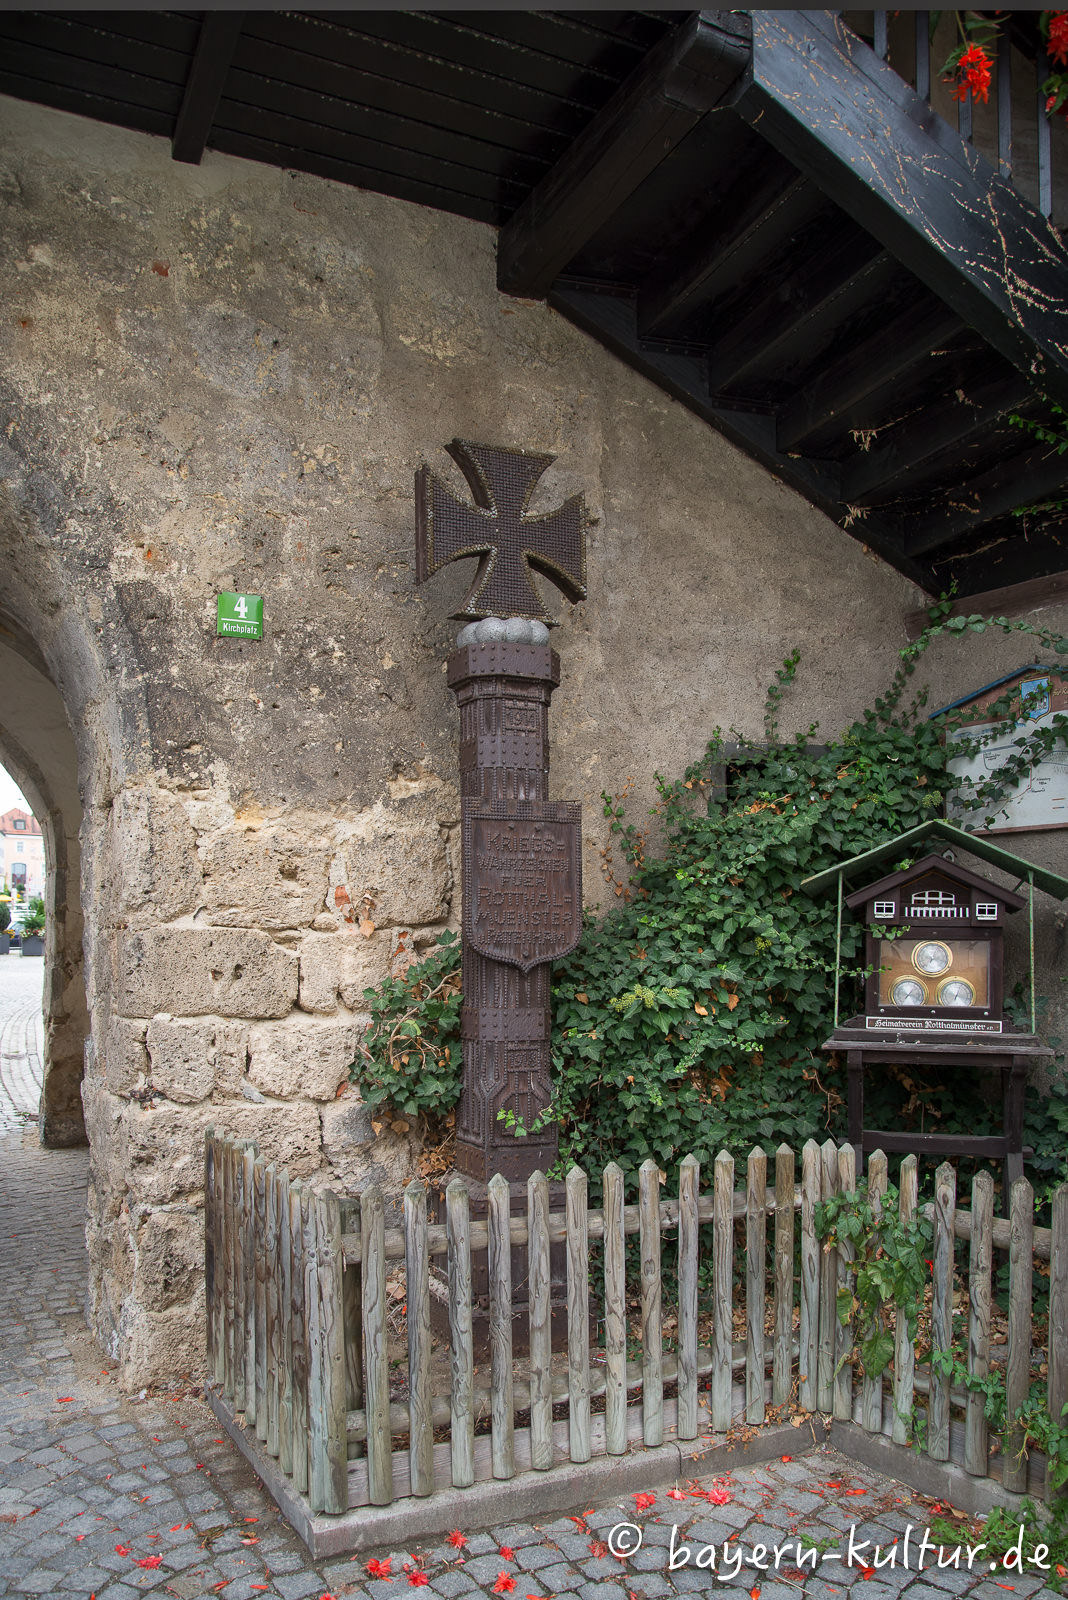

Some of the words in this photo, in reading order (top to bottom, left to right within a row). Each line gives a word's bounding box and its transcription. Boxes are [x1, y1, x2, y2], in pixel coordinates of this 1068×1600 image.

[234, 596, 248, 619] 4
[223, 622, 258, 635] Kirchplatz
[500, 875, 547, 887] FUER
[473, 909, 574, 926] MUENSTER
[874, 1018, 923, 1029] Heimatverein
[924, 1020, 986, 1031] Rotthalmünster
